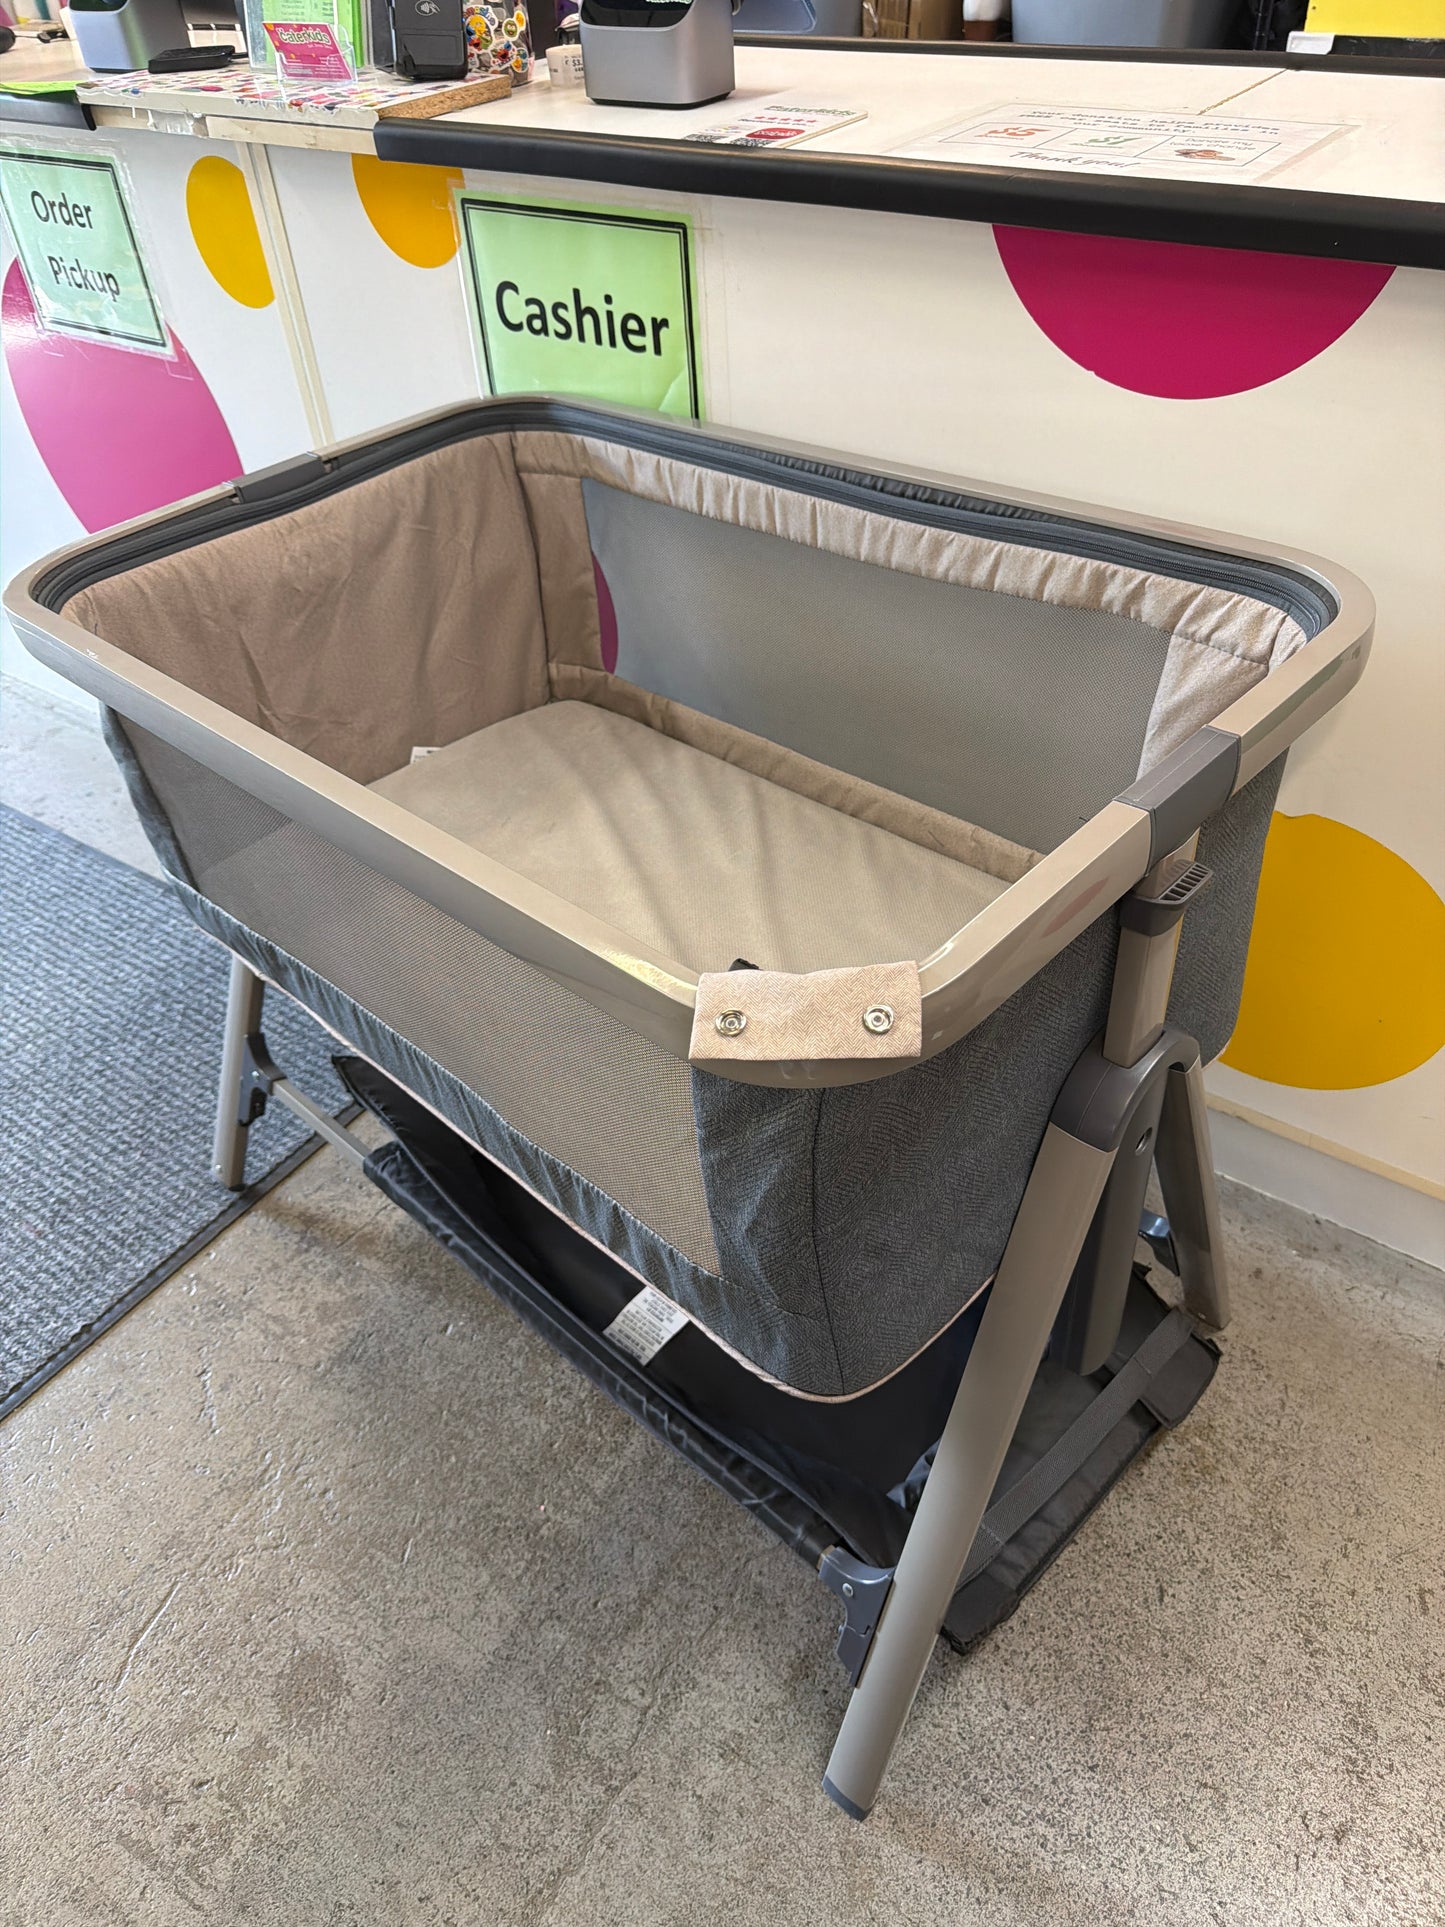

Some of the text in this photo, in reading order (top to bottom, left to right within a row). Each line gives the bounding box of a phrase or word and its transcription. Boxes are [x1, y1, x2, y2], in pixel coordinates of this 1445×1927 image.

[1071, 113, 1141, 122] donation
[1202, 122, 1281, 131] provides
[984, 127, 1051, 137] $5
[1084, 136, 1143, 145] $1
[1206, 143, 1257, 151] change
[1009, 151, 1142, 168] Thank you!
[30, 190, 93, 229] Order
[47, 255, 120, 302] Pickup
[496, 281, 669, 356] Cashier
